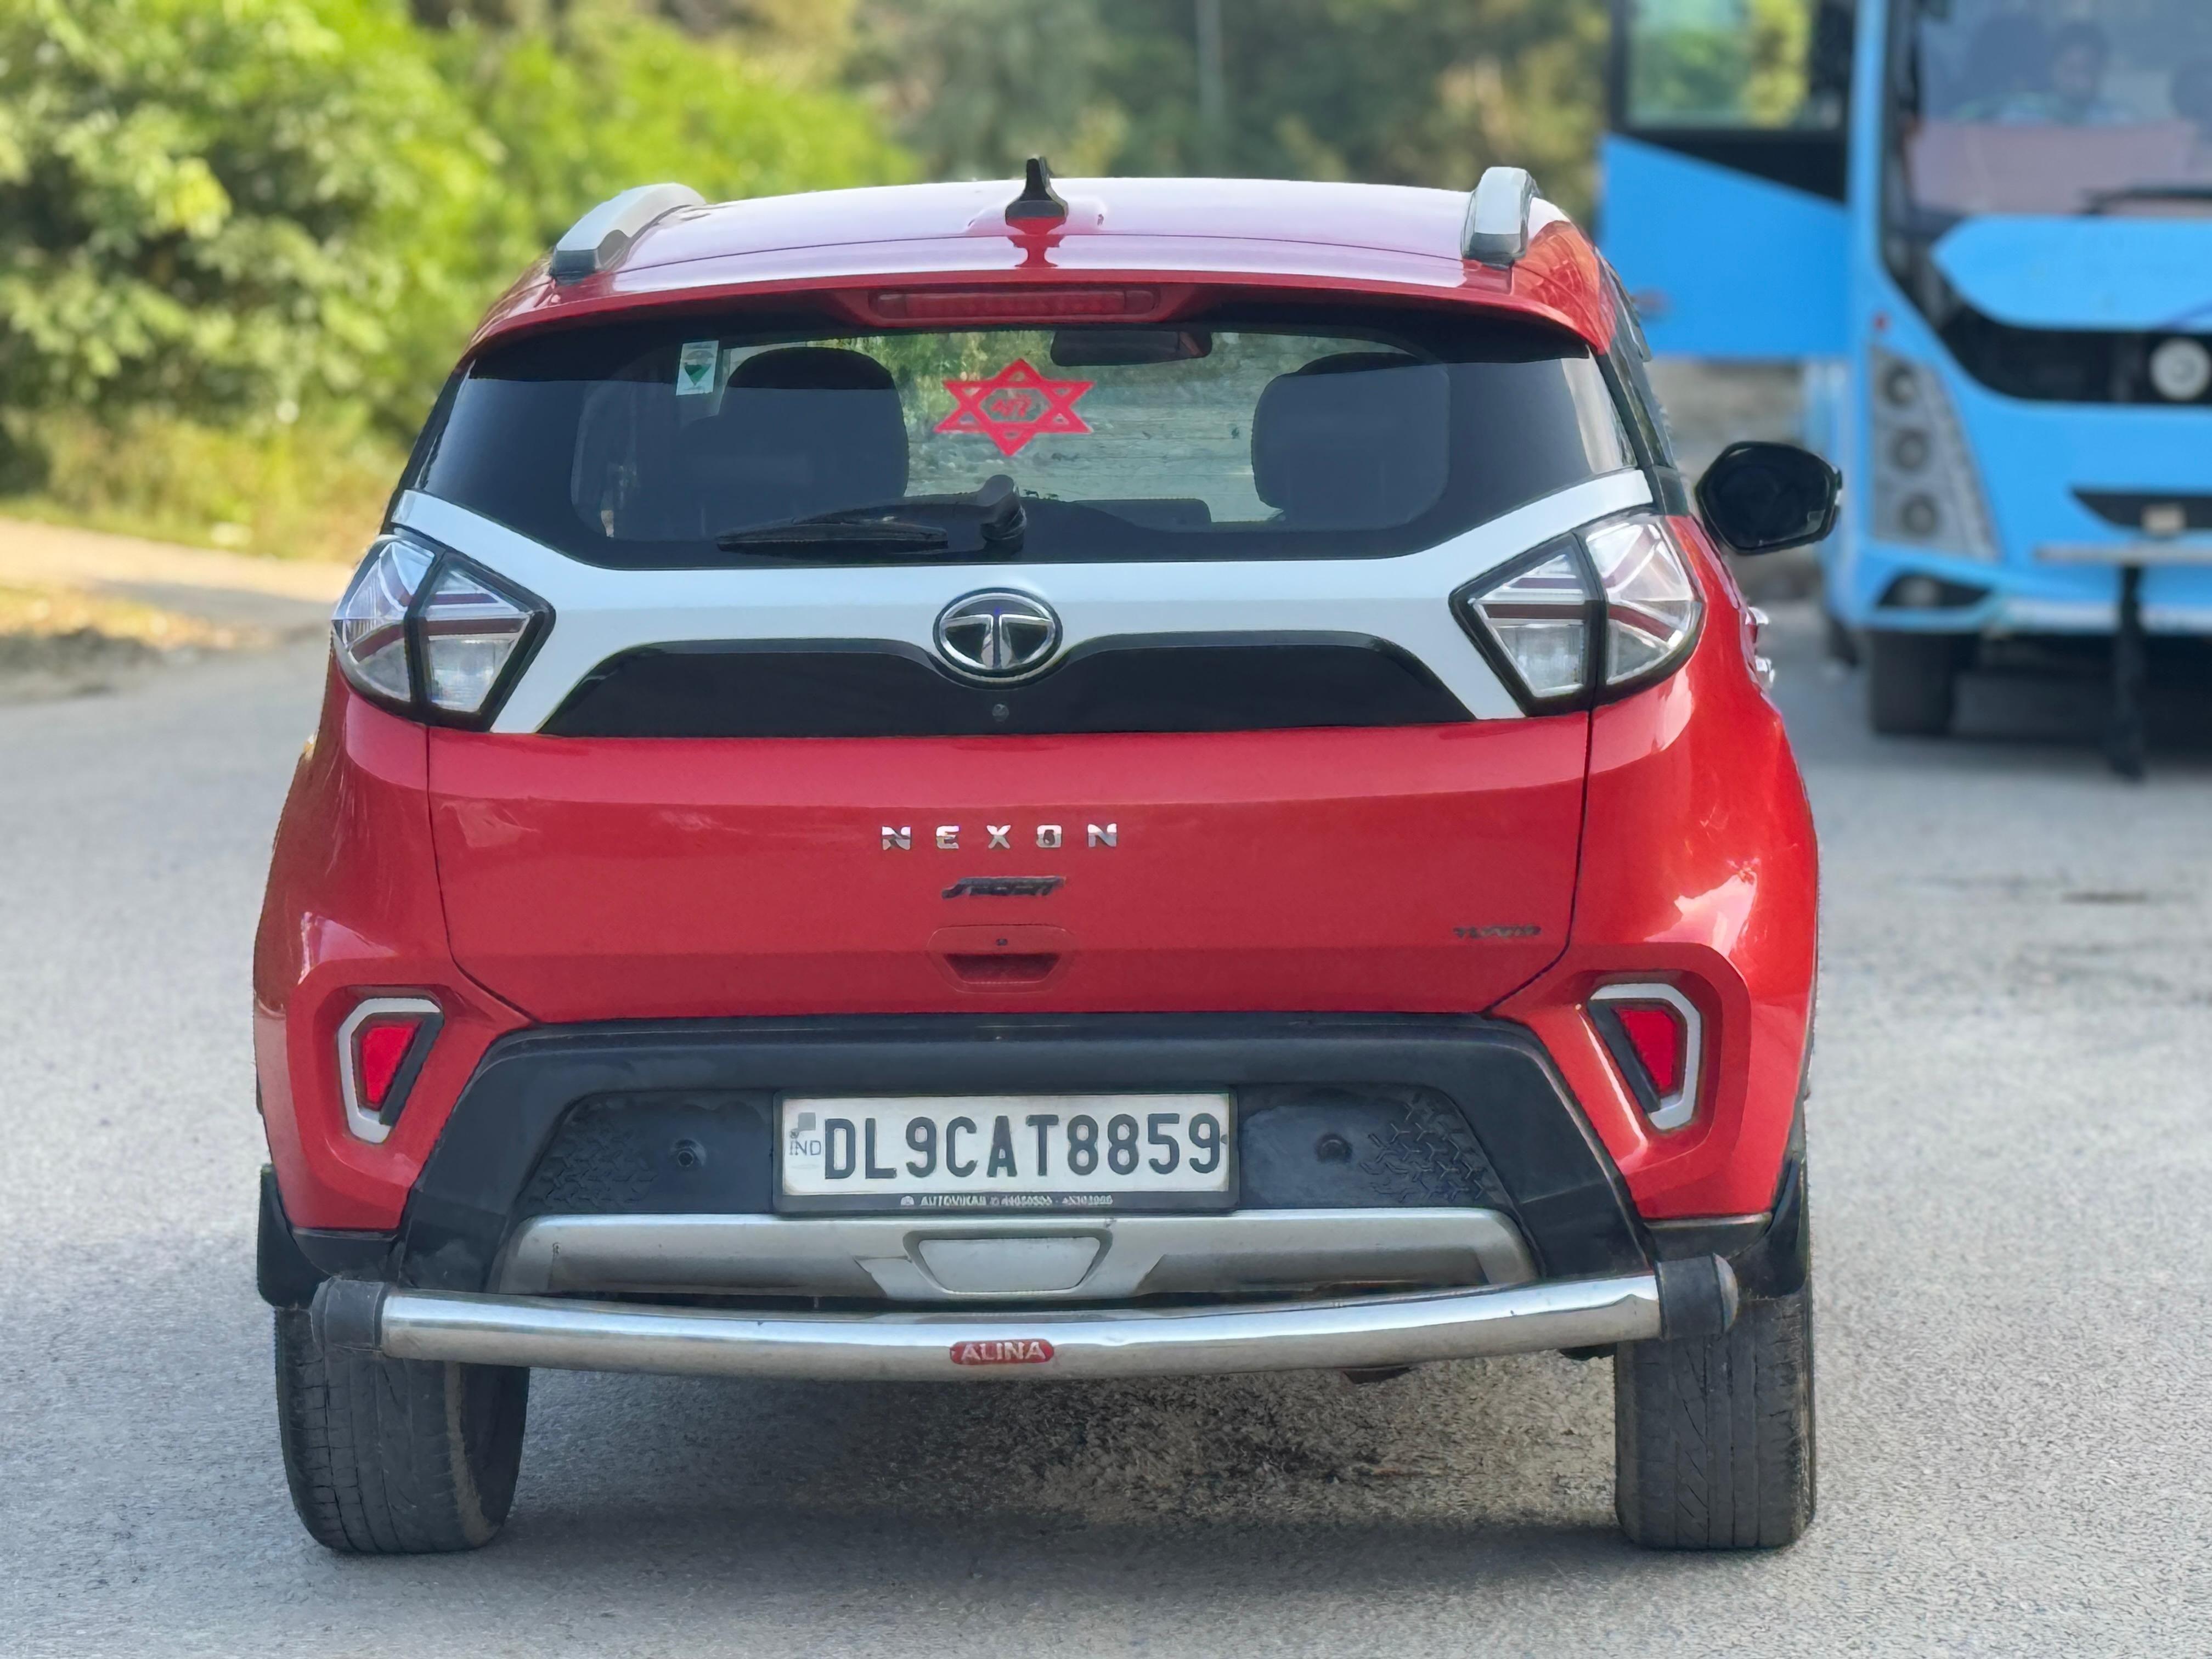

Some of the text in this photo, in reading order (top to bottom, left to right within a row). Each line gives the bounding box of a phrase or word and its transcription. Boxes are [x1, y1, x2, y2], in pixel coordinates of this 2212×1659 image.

[881, 823, 1118, 850] NEXON
[789, 1139, 822, 1155] IND
[825, 1113, 1220, 1180] DL9CAT8859
[961, 1341, 1046, 1361] ALINA
